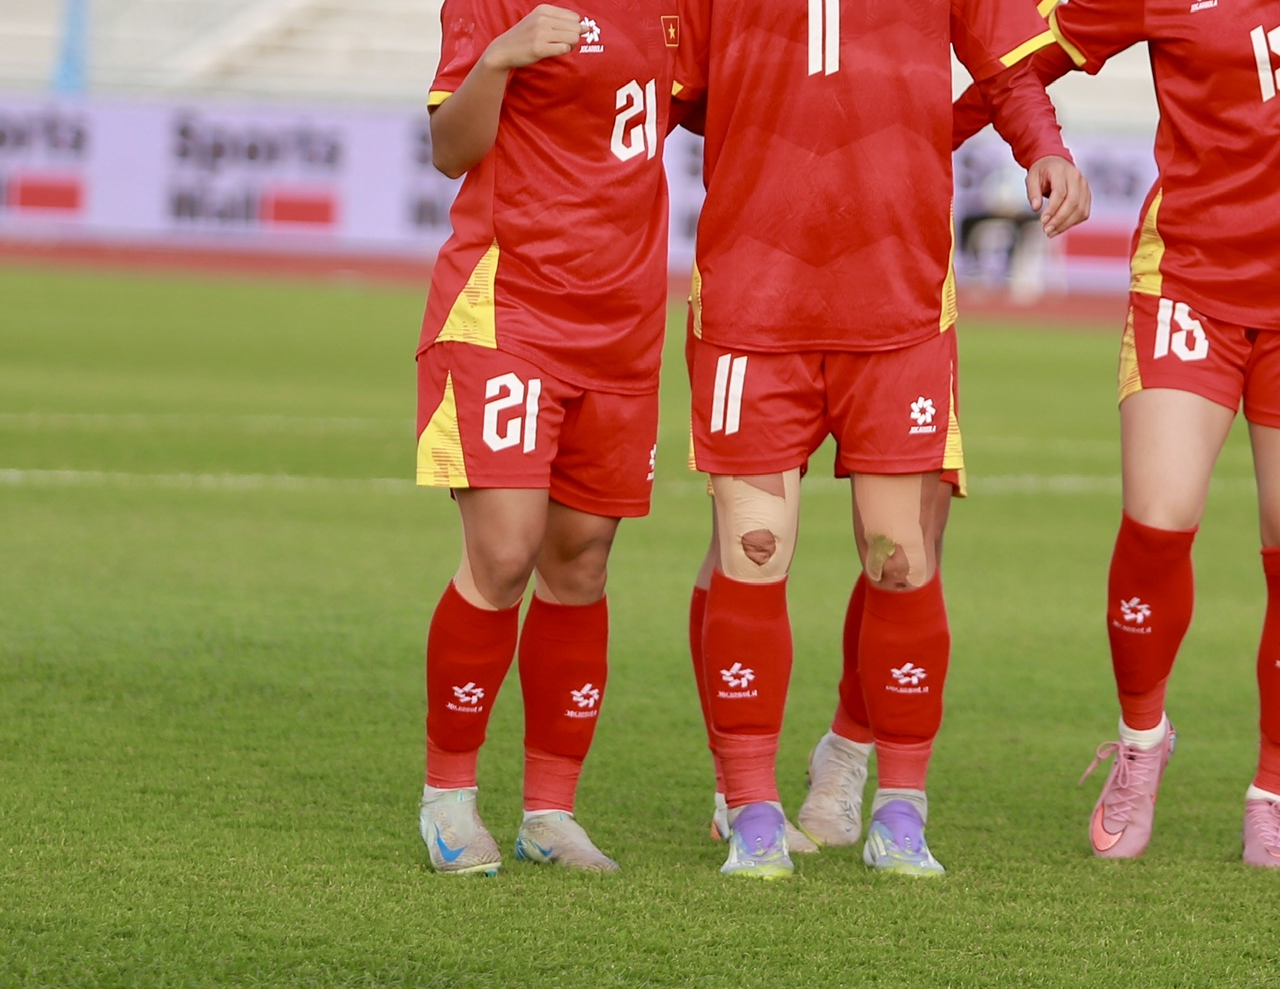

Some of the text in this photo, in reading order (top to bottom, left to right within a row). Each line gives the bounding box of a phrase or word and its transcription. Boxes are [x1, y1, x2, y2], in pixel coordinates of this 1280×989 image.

[610, 78, 657, 162] 21
[482, 372, 542, 454] 21
[710, 353, 748, 435] 11
